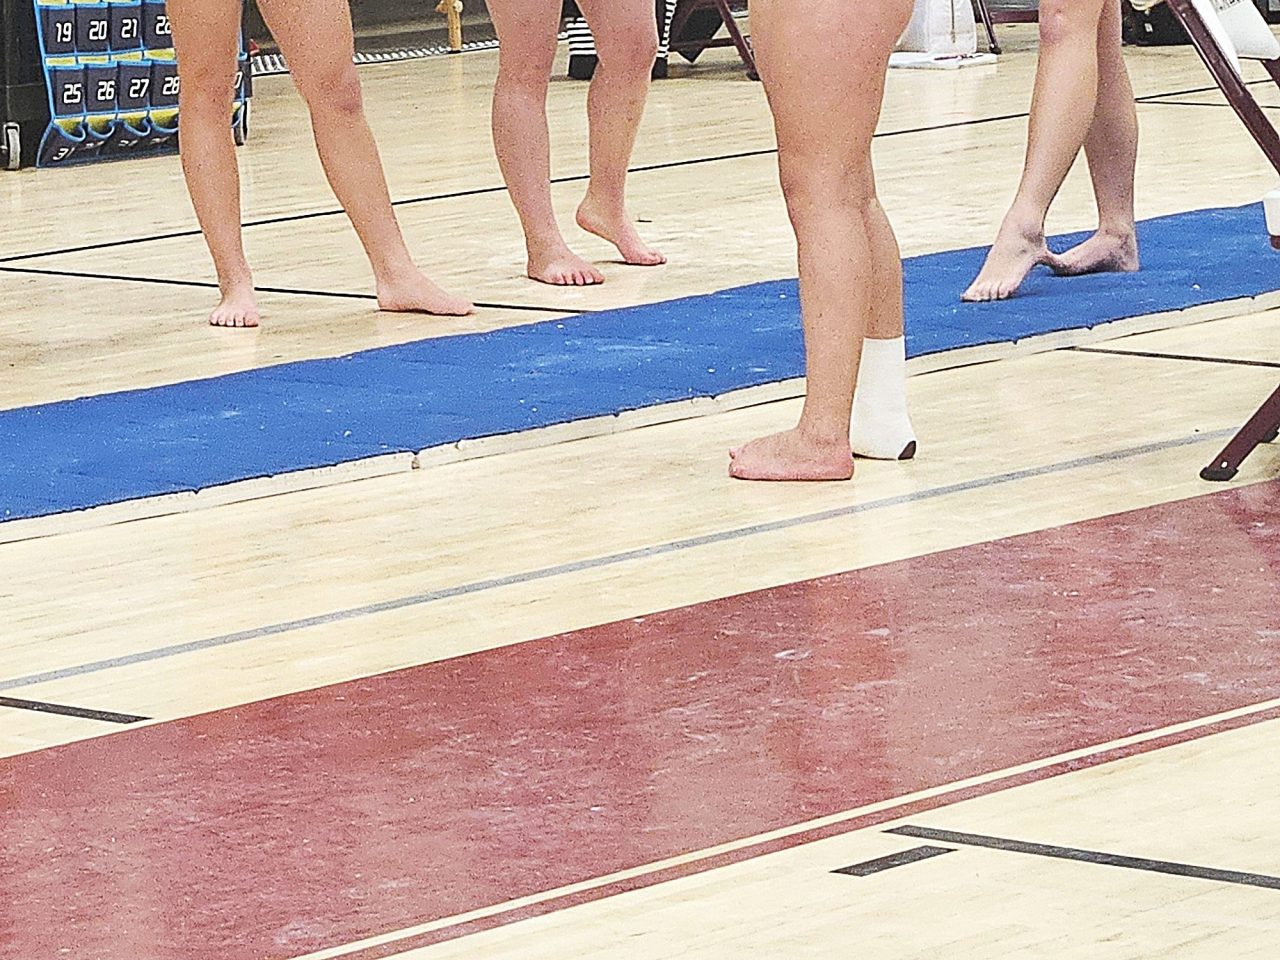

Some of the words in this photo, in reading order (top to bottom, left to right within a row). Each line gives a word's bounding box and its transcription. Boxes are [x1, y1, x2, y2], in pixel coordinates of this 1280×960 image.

[55, 22, 72, 42] 19
[88, 20, 108, 40] 20
[121, 18, 138, 38] 21
[63, 83, 82, 104] 25
[97, 80, 115, 101] 26
[129, 78, 150, 98] 27
[162, 76, 180, 95] 28
